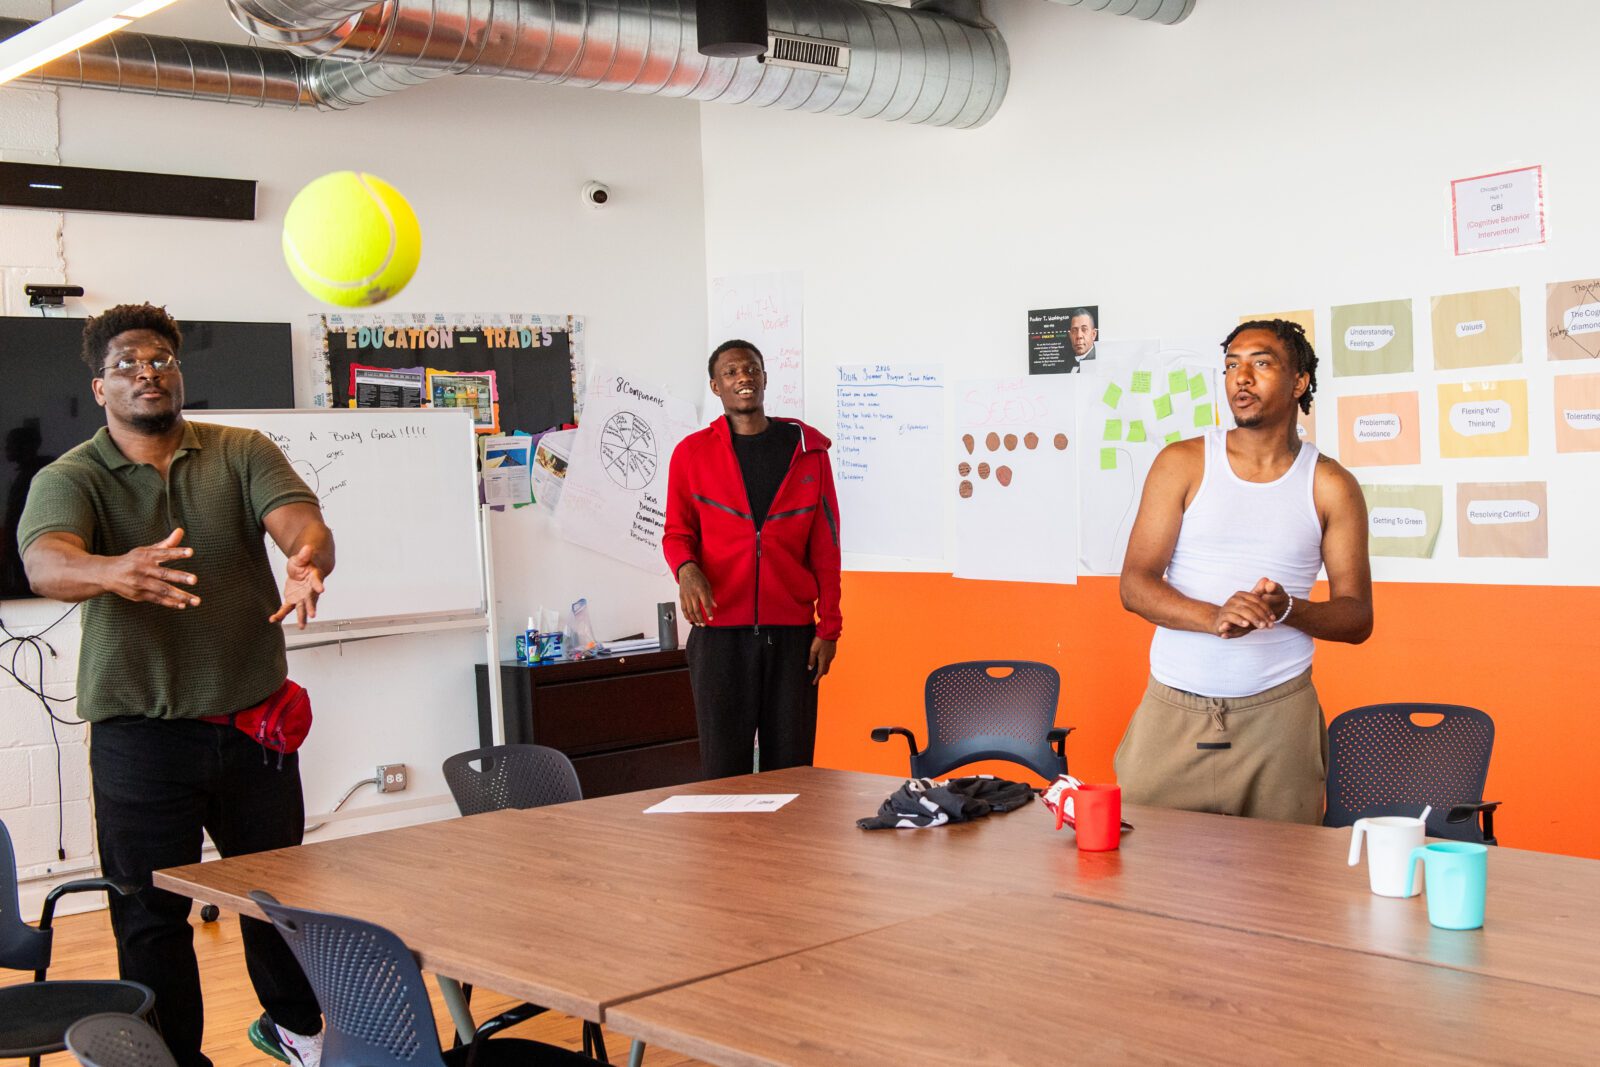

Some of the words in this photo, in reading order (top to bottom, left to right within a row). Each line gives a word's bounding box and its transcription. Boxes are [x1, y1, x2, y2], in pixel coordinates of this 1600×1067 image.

[1467, 218, 1500, 230] (Cognitive
[1501, 213, 1529, 223] Behavior
[1478, 226, 1520, 239] Intervention)
[1461, 321, 1483, 331] Values
[1350, 327, 1394, 338] Understanding
[347, 327, 453, 349] EDUCATION
[484, 327, 552, 348] TRADES
[1350, 339, 1375, 349] Feelings
[617, 377, 624, 392] 8
[623, 381, 664, 407] Components
[1566, 412, 1600, 422] Tolerating
[1359, 418, 1396, 427] Problematic
[1468, 420, 1495, 428] Thinking
[310, 432, 317, 441] A
[328, 431, 362, 443] Body
[1359, 430, 1391, 438] Avoidance
[1470, 511, 1502, 519] Resolving
[1503, 510, 1530, 518] Conflict
[1373, 517, 1396, 526] Getting
[1397, 517, 1404, 525] To
